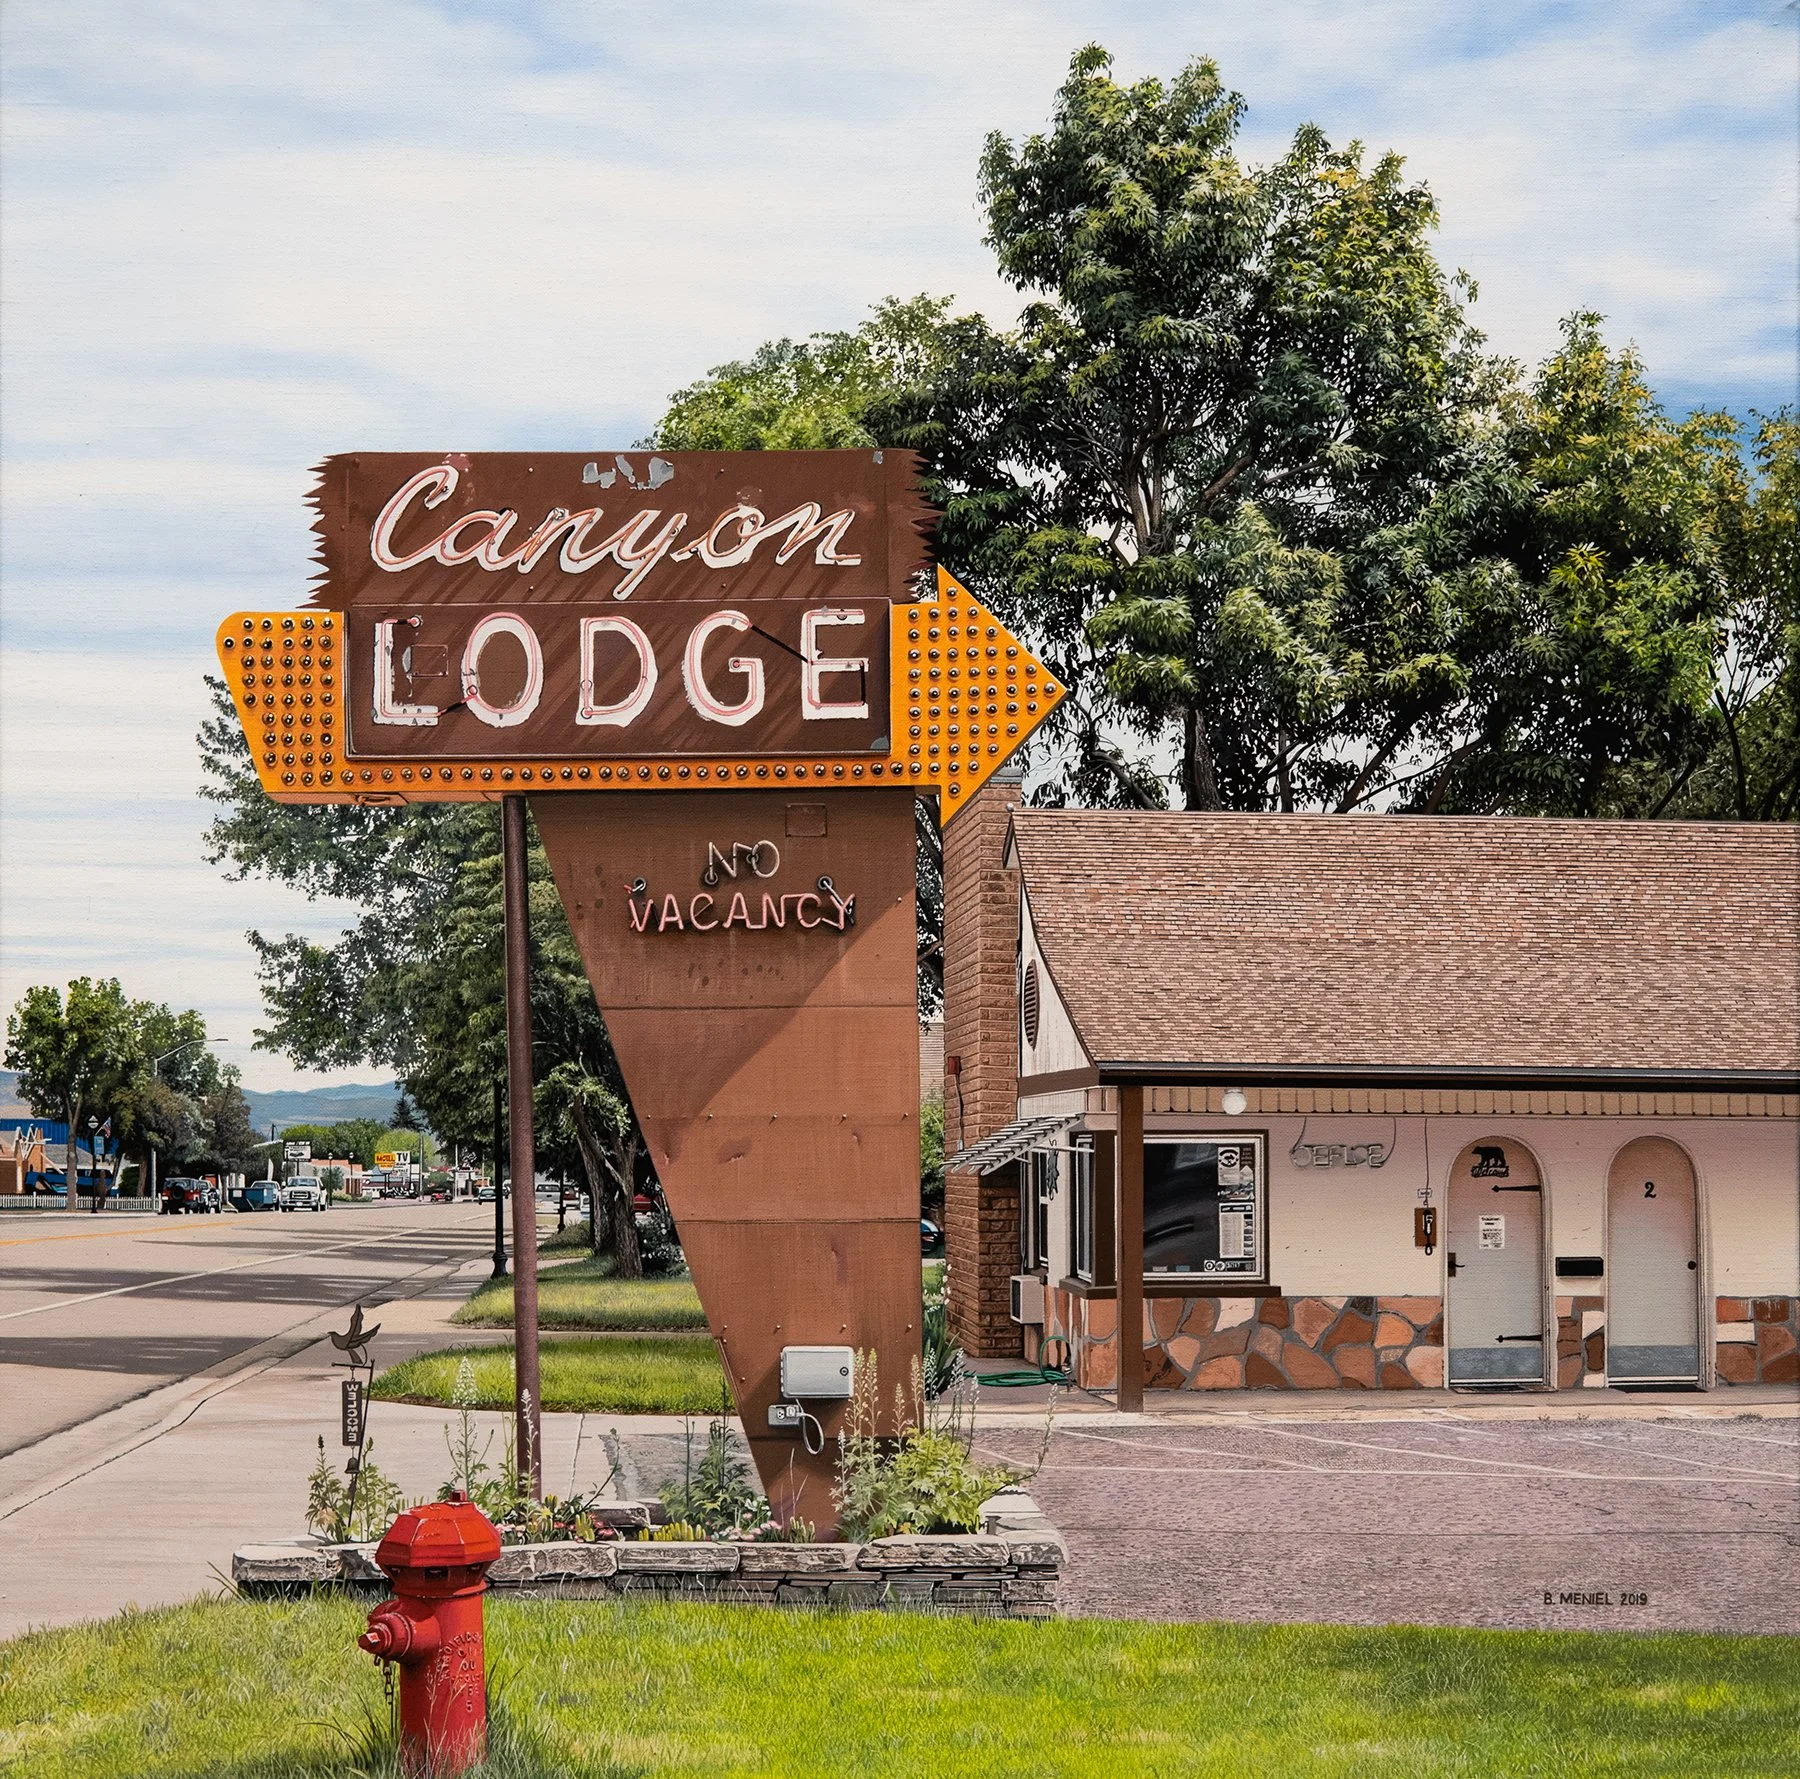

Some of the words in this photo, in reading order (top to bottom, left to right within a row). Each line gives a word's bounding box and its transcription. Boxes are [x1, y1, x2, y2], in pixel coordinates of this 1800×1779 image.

[370, 465, 862, 600] Canyon
[372, 609, 870, 727] LODGE
[707, 839, 781, 878] NO
[628, 892, 856, 932] VACANCY
[396, 1153, 408, 1162] TV
[1644, 1181, 1657, 1199] 2
[346, 1384, 359, 1443] WELCOME
[1543, 1592, 1556, 1606] B.
[1559, 1592, 1614, 1606] MENIEL
[1620, 1592, 1648, 1606] 2019
